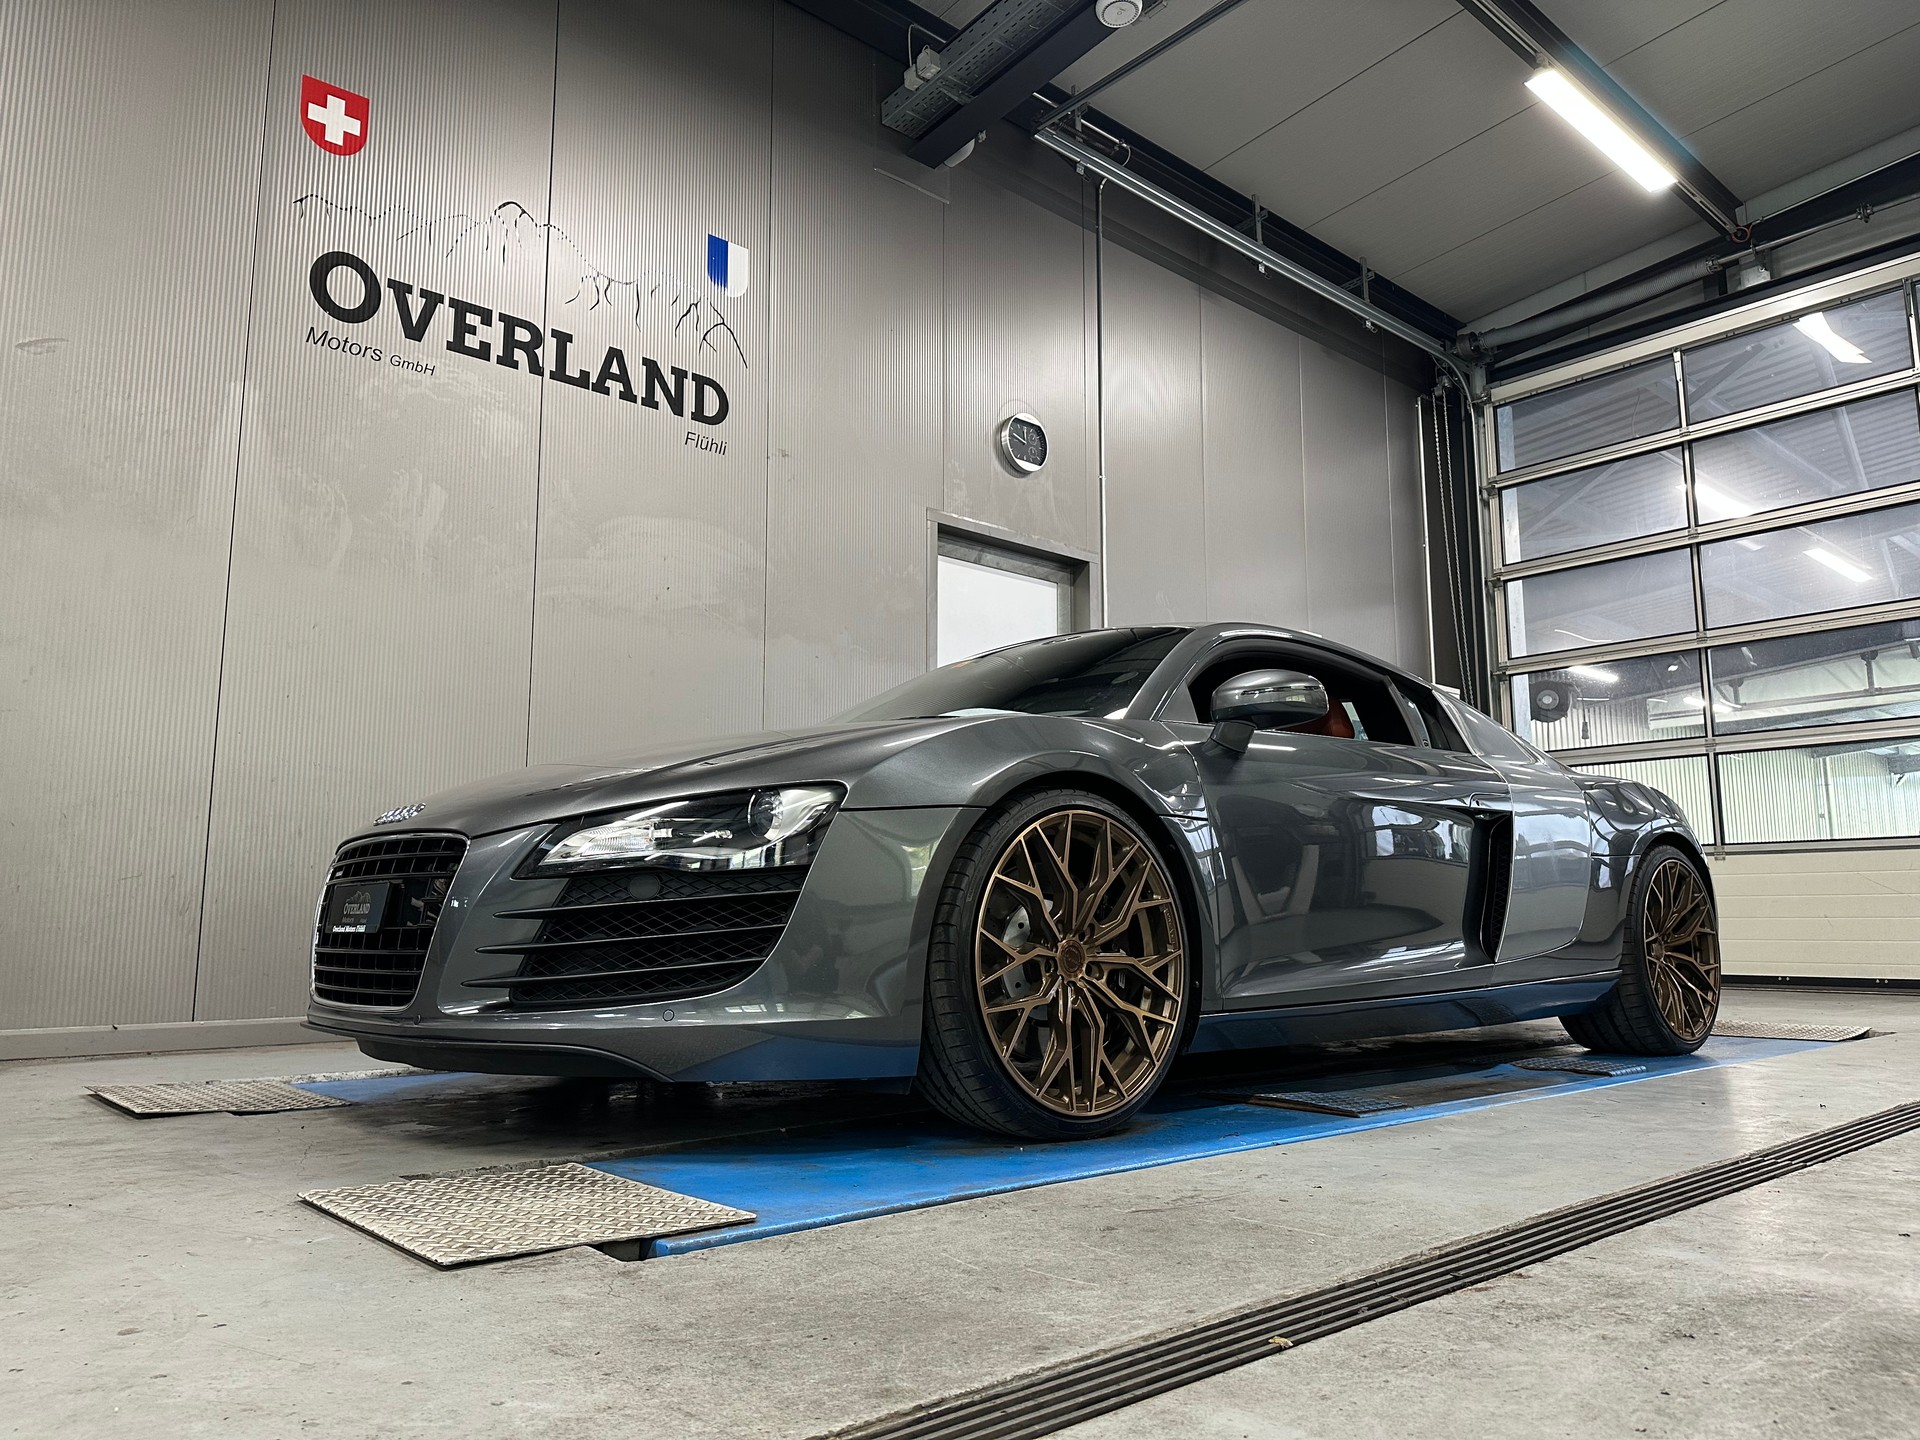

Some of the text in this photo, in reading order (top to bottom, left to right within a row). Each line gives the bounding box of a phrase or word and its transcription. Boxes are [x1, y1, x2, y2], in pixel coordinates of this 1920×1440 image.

[305, 326, 436, 376] Motors GmbH
[309, 250, 729, 426] OVERLAND
[685, 431, 727, 456] Flühli
[343, 903, 370, 915] OVERLAND
